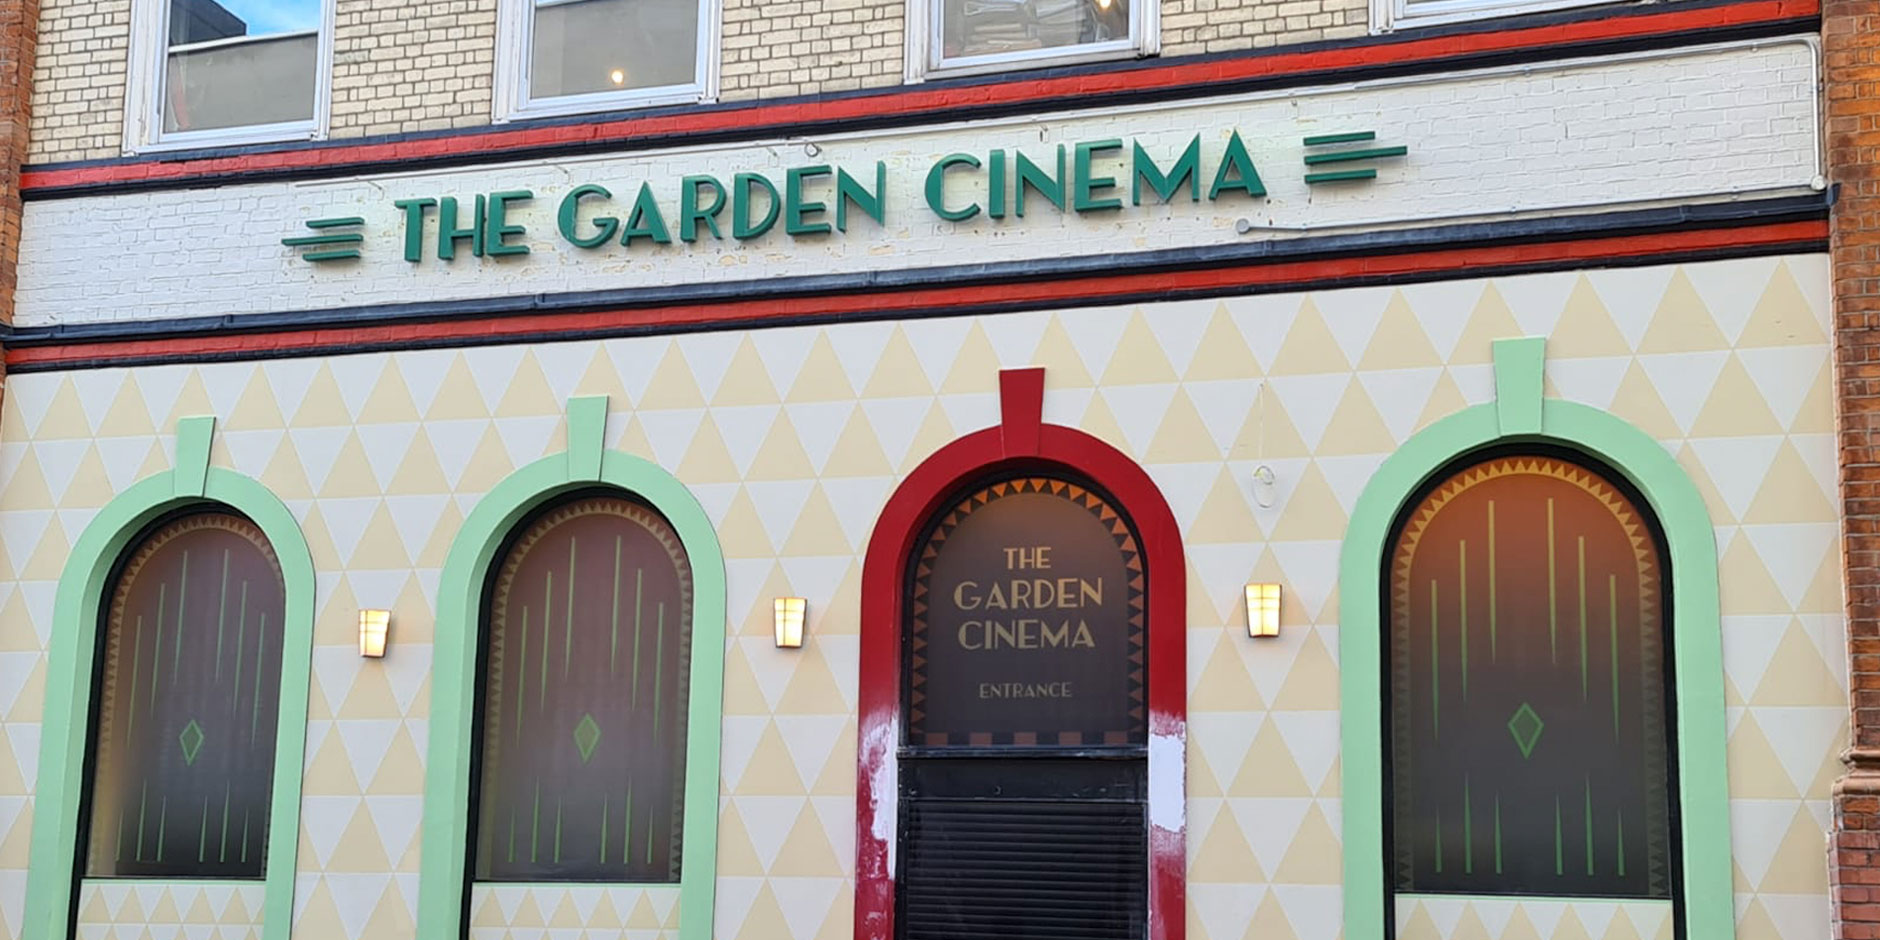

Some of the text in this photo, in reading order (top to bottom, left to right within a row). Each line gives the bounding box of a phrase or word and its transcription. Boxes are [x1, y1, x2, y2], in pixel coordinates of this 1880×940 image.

[395, 131, 1267, 262] THE GARDEN CINEMA
[1003, 546, 1052, 570] THE
[953, 576, 1103, 610] GARDEN
[958, 619, 1096, 650] CINEMA
[979, 681, 1073, 699] ENTRANCE
